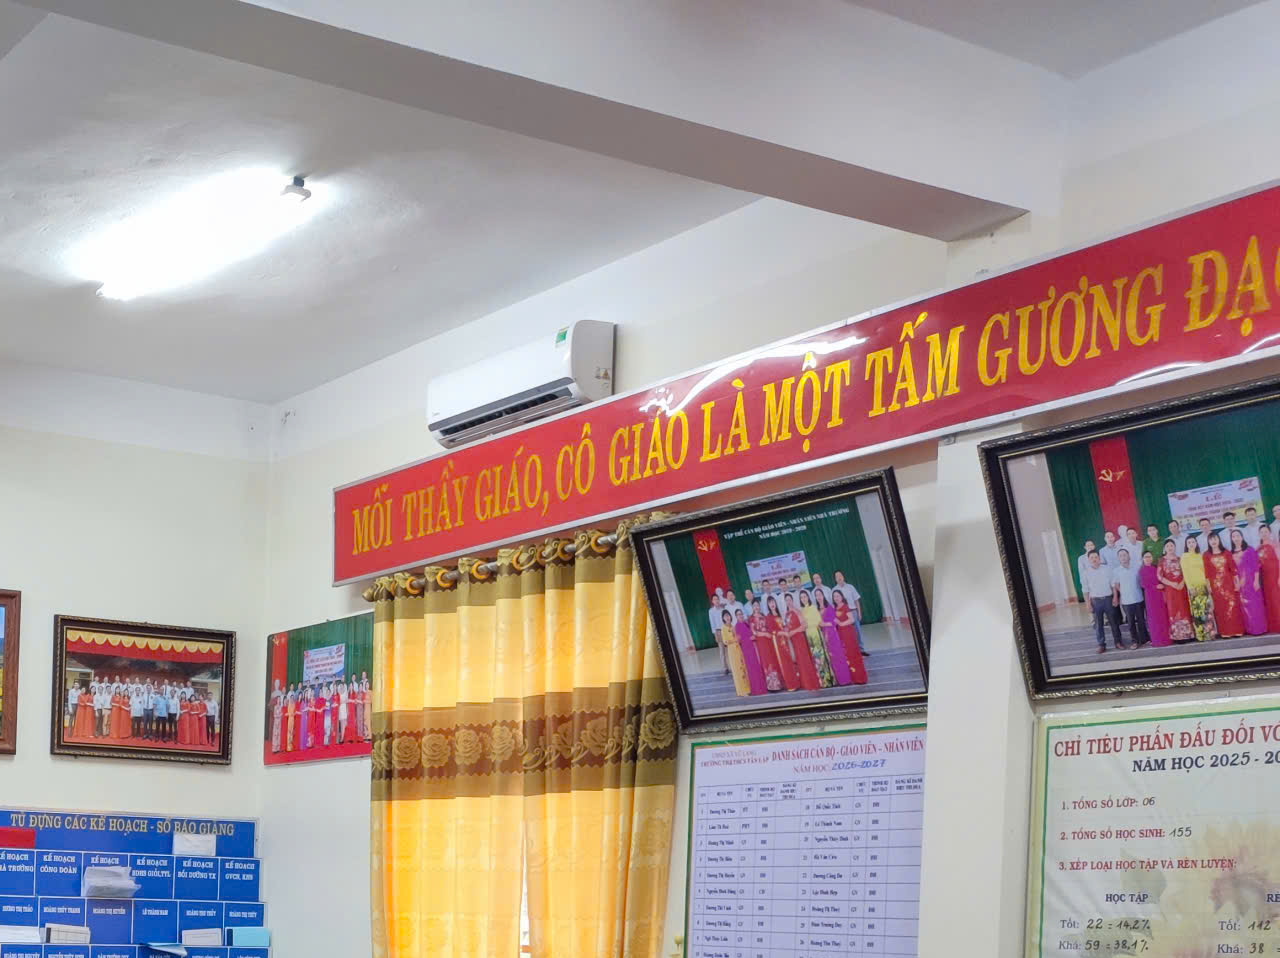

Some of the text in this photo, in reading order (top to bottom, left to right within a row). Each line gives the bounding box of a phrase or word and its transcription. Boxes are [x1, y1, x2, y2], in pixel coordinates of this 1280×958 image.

[352, 235, 1280, 555] MỖI THẦY GIÁO, CÔ GIÁO LÀ MỘT TẤM GƯƠNG ĐẠ
[1054, 734, 1081, 757] CHỈ
[1086, 733, 1123, 754] TIÊU
[1129, 725, 1174, 752] PHẤN
[1180, 721, 1216, 748] ĐẤU
[1222, 718, 1255, 745] ĐỐI
[1132, 757, 1167, 772] NĂM
[1171, 756, 1204, 773] HỌC
[1210, 752, 1250, 767] 2025
[1072, 796, 1097, 810] TỔNG
[1100, 795, 1113, 808] SỐ
[1142, 797, 1155, 806] 06
[29, 814, 61, 830] ĐỰNG
[65, 815, 87, 829] CÁC
[89, 815, 106, 830] KẾ
[109, 818, 148, 836] HOẠCH
[174, 819, 197, 834] BÁO
[1072, 826, 1192, 842] TỔNG SỐ HỌC SINH: 155
[1069, 857, 1088, 870] XẾP
[1090, 861, 1112, 872] LOẠI
[1115, 860, 1136, 872] HỌC
[1139, 858, 1158, 872] TẬP
[1201, 856, 1237, 871] LUYỆN:
[1105, 891, 1148, 904] HỌC TẬP
[1086, 918, 1103, 929] 22
[1218, 919, 1240, 931] Tốt:
[1084, 939, 1100, 950] 59
[1217, 943, 1264, 954] Khá: 38
